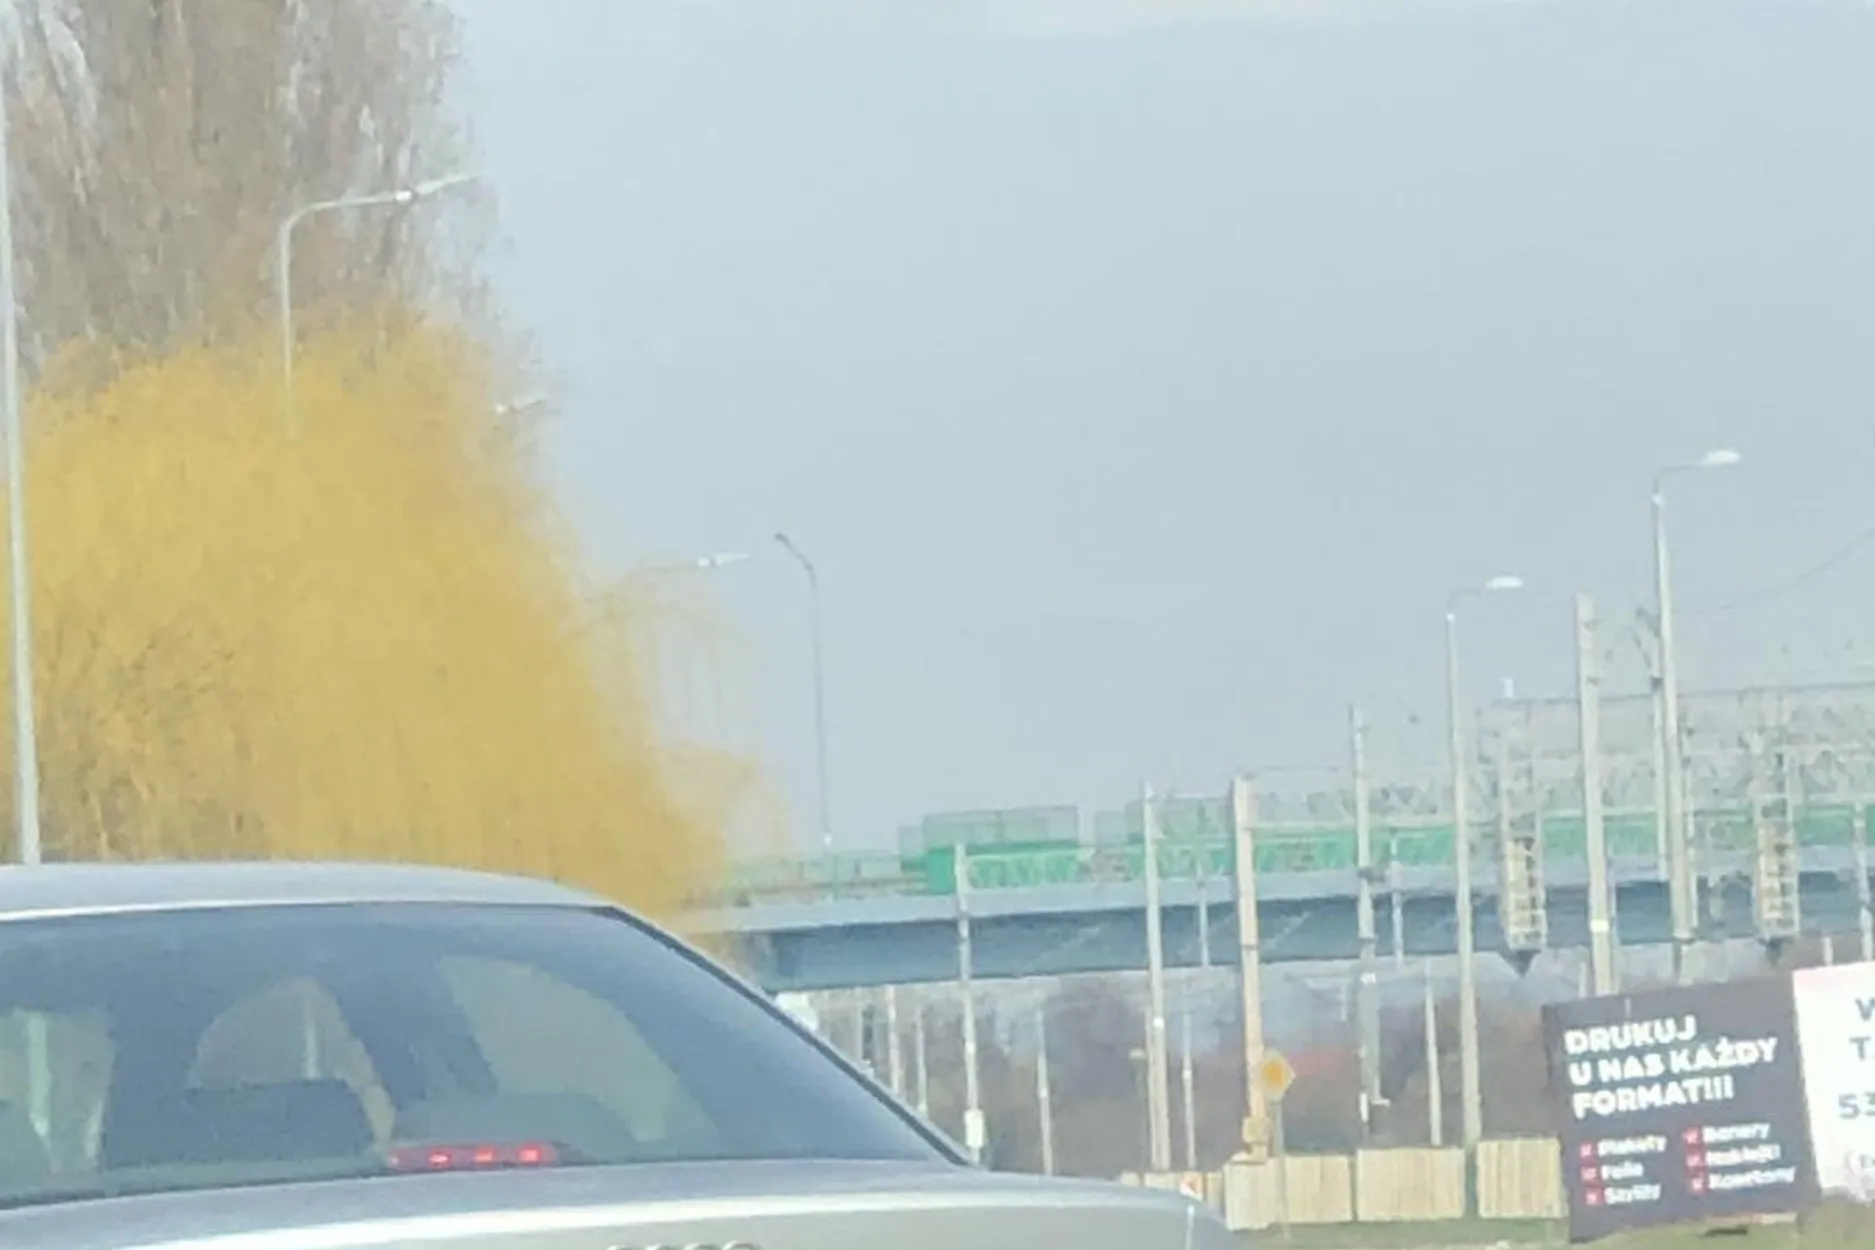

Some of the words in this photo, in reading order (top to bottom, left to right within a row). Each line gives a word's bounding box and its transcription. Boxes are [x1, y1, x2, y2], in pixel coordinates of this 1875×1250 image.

[1564, 1016, 1697, 1054] DRUKUJ
[1569, 1061, 1593, 1086] U
[1597, 1053, 1665, 1083] NAS
[1669, 1036, 1778, 1074] KAŻDY
